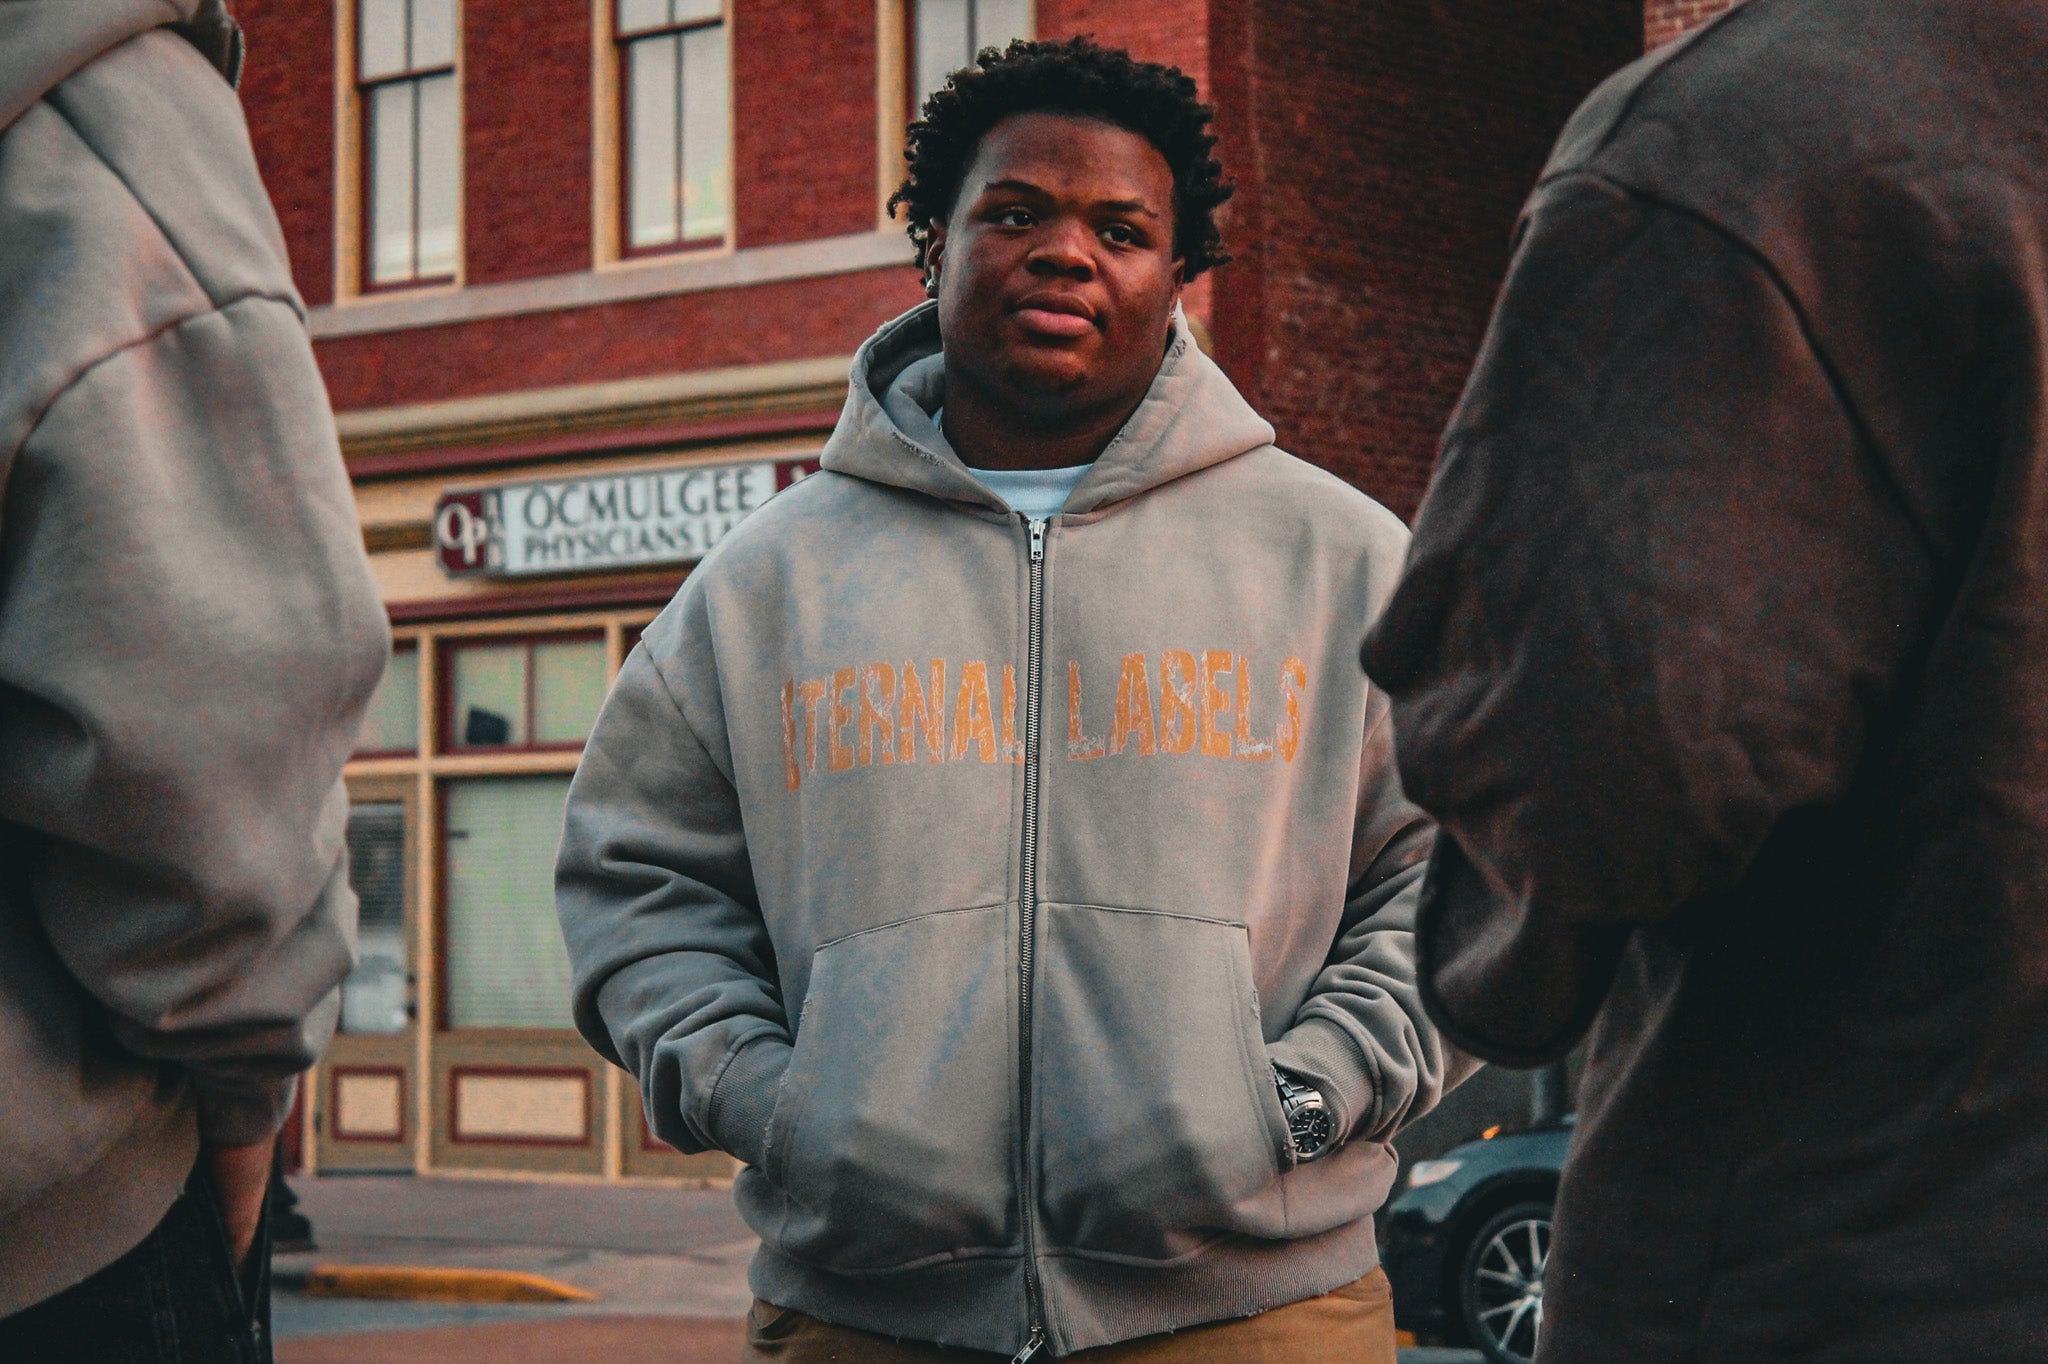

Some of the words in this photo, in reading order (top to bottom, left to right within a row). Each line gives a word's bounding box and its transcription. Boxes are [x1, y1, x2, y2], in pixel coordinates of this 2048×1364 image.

[523, 467, 754, 530] OCMULGEE
[524, 523, 693, 563] PHYSICIANS
[1067, 649, 1307, 763] LABELS
